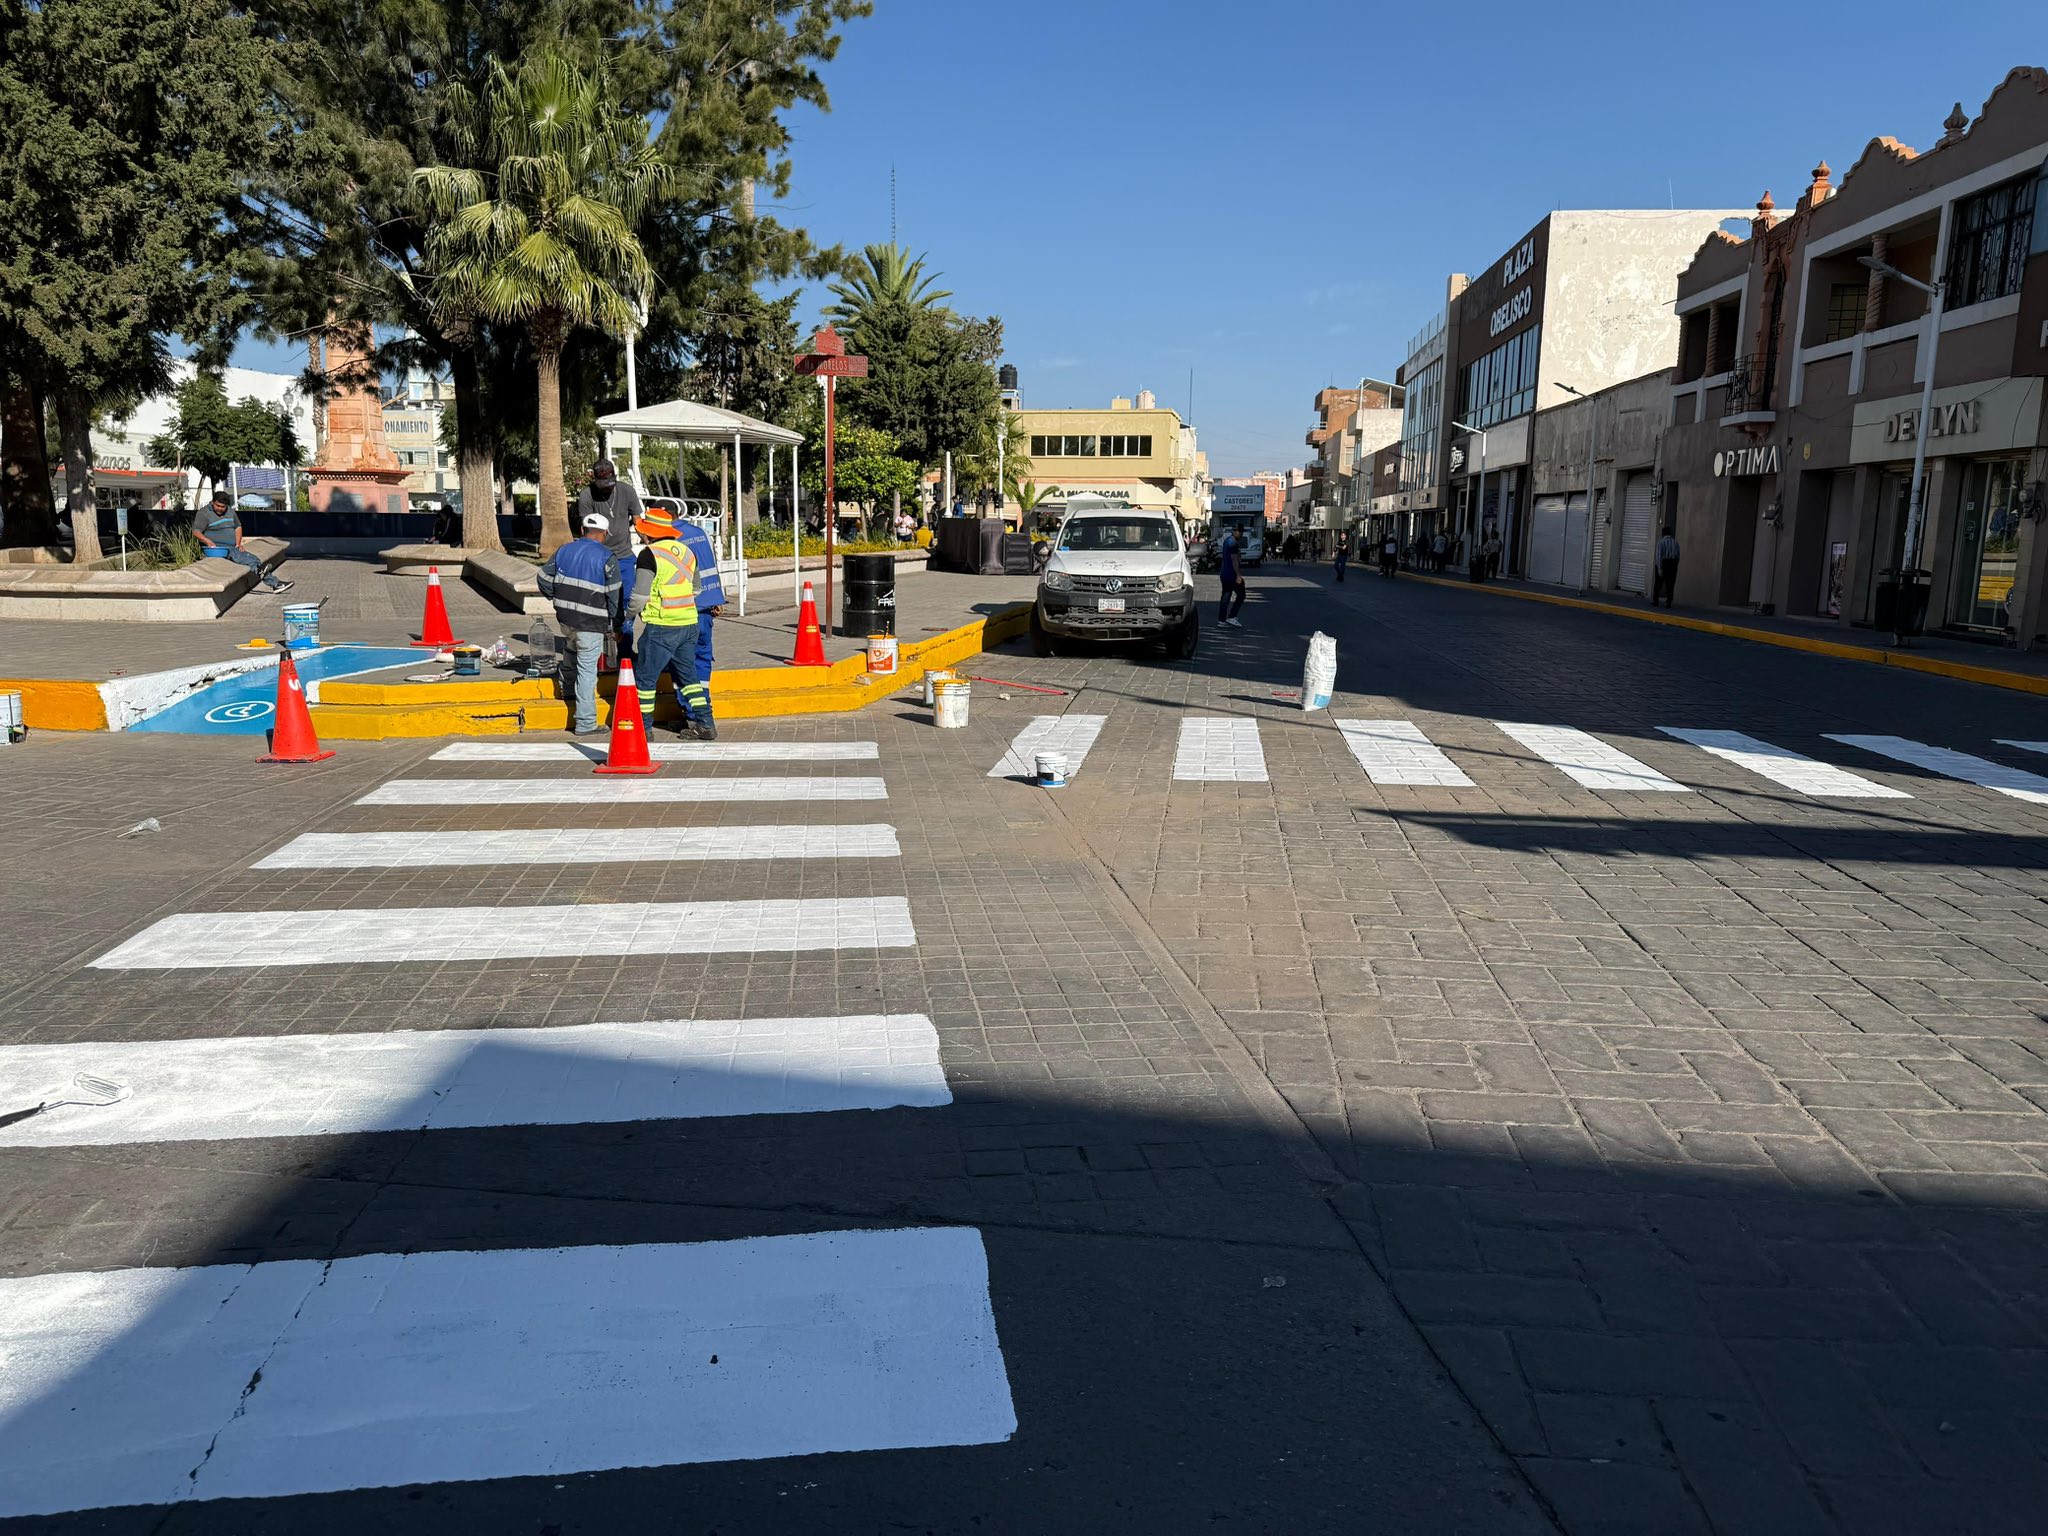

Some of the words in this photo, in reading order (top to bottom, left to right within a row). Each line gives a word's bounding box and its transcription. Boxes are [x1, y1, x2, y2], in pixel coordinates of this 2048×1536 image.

[1503, 237, 1535, 288] PLAZA
[1490, 285, 1532, 338] OBELISCO
[1714, 445, 1778, 477] OPTIMA
